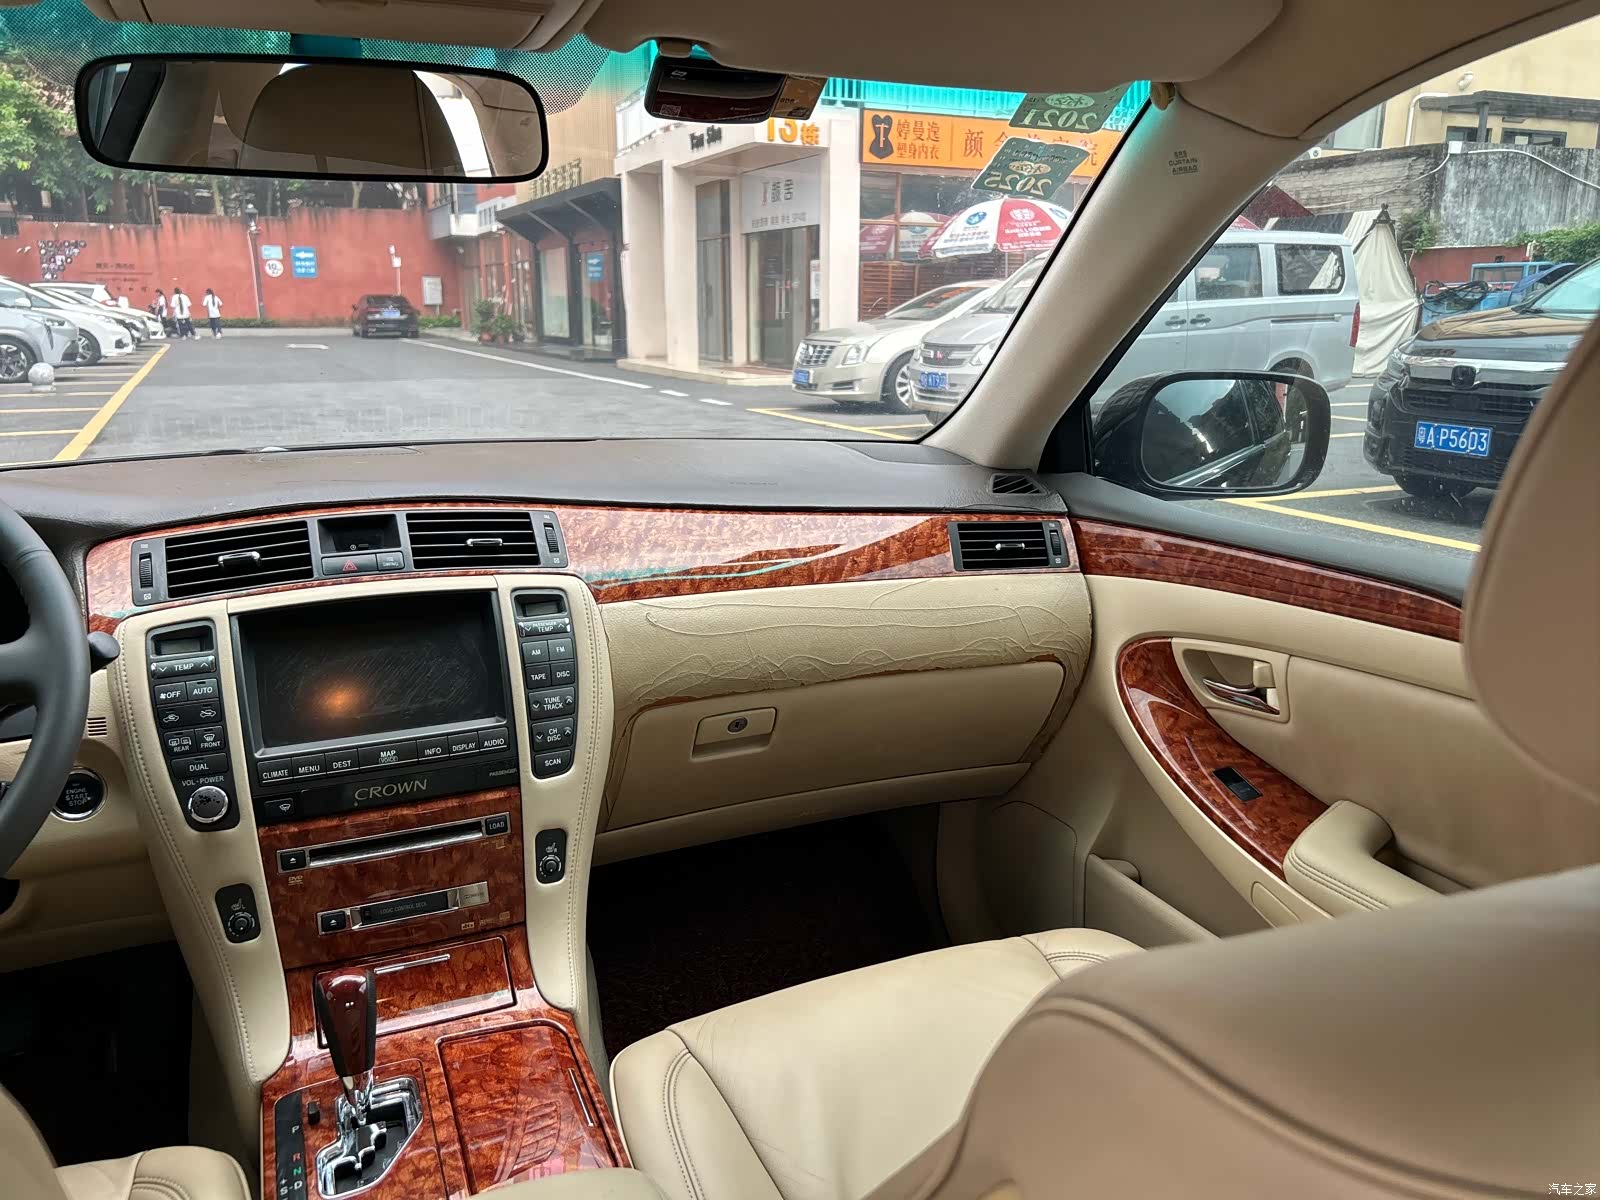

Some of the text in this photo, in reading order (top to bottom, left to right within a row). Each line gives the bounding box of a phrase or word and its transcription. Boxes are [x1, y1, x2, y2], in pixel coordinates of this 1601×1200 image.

[1168, 158, 1198, 167] CURTAIN
[537, 625, 554, 633] TEMP
[531, 648, 542, 656] AM
[174, 662, 195, 672] TEMP
[530, 672, 547, 681] TAPE
[556, 670, 571, 678] DISC
[166, 690, 182, 699] OFF
[193, 686, 213, 696] AUTO
[543, 695, 561, 704] TUNE
[543, 702, 564, 711] TRACK
[548, 727, 558, 735] CH
[483, 737, 505, 747] AUDIO
[546, 734, 562, 742] DISC
[173, 745, 190, 753] REAR
[200, 740, 221, 749] FRONT
[452, 741, 476, 752] DISPLAY
[380, 749, 396, 758] MAP
[424, 747, 442, 756] INFO
[332, 760, 352, 769] DEST
[544, 758, 562, 767] SCAN
[189, 763, 210, 772] DUAL
[298, 764, 321, 775] MENU
[262, 768, 289, 780] CLIMATE
[65, 787, 87, 795] ENGINE
[354, 778, 428, 801] CROWN
[65, 792, 88, 801] START
[68, 798, 87, 807] STOP
[489, 821, 505, 830] LOAD
[291, 1125, 300, 1134] P
[292, 1152, 301, 1162] R
[293, 1166, 302, 1175] N
